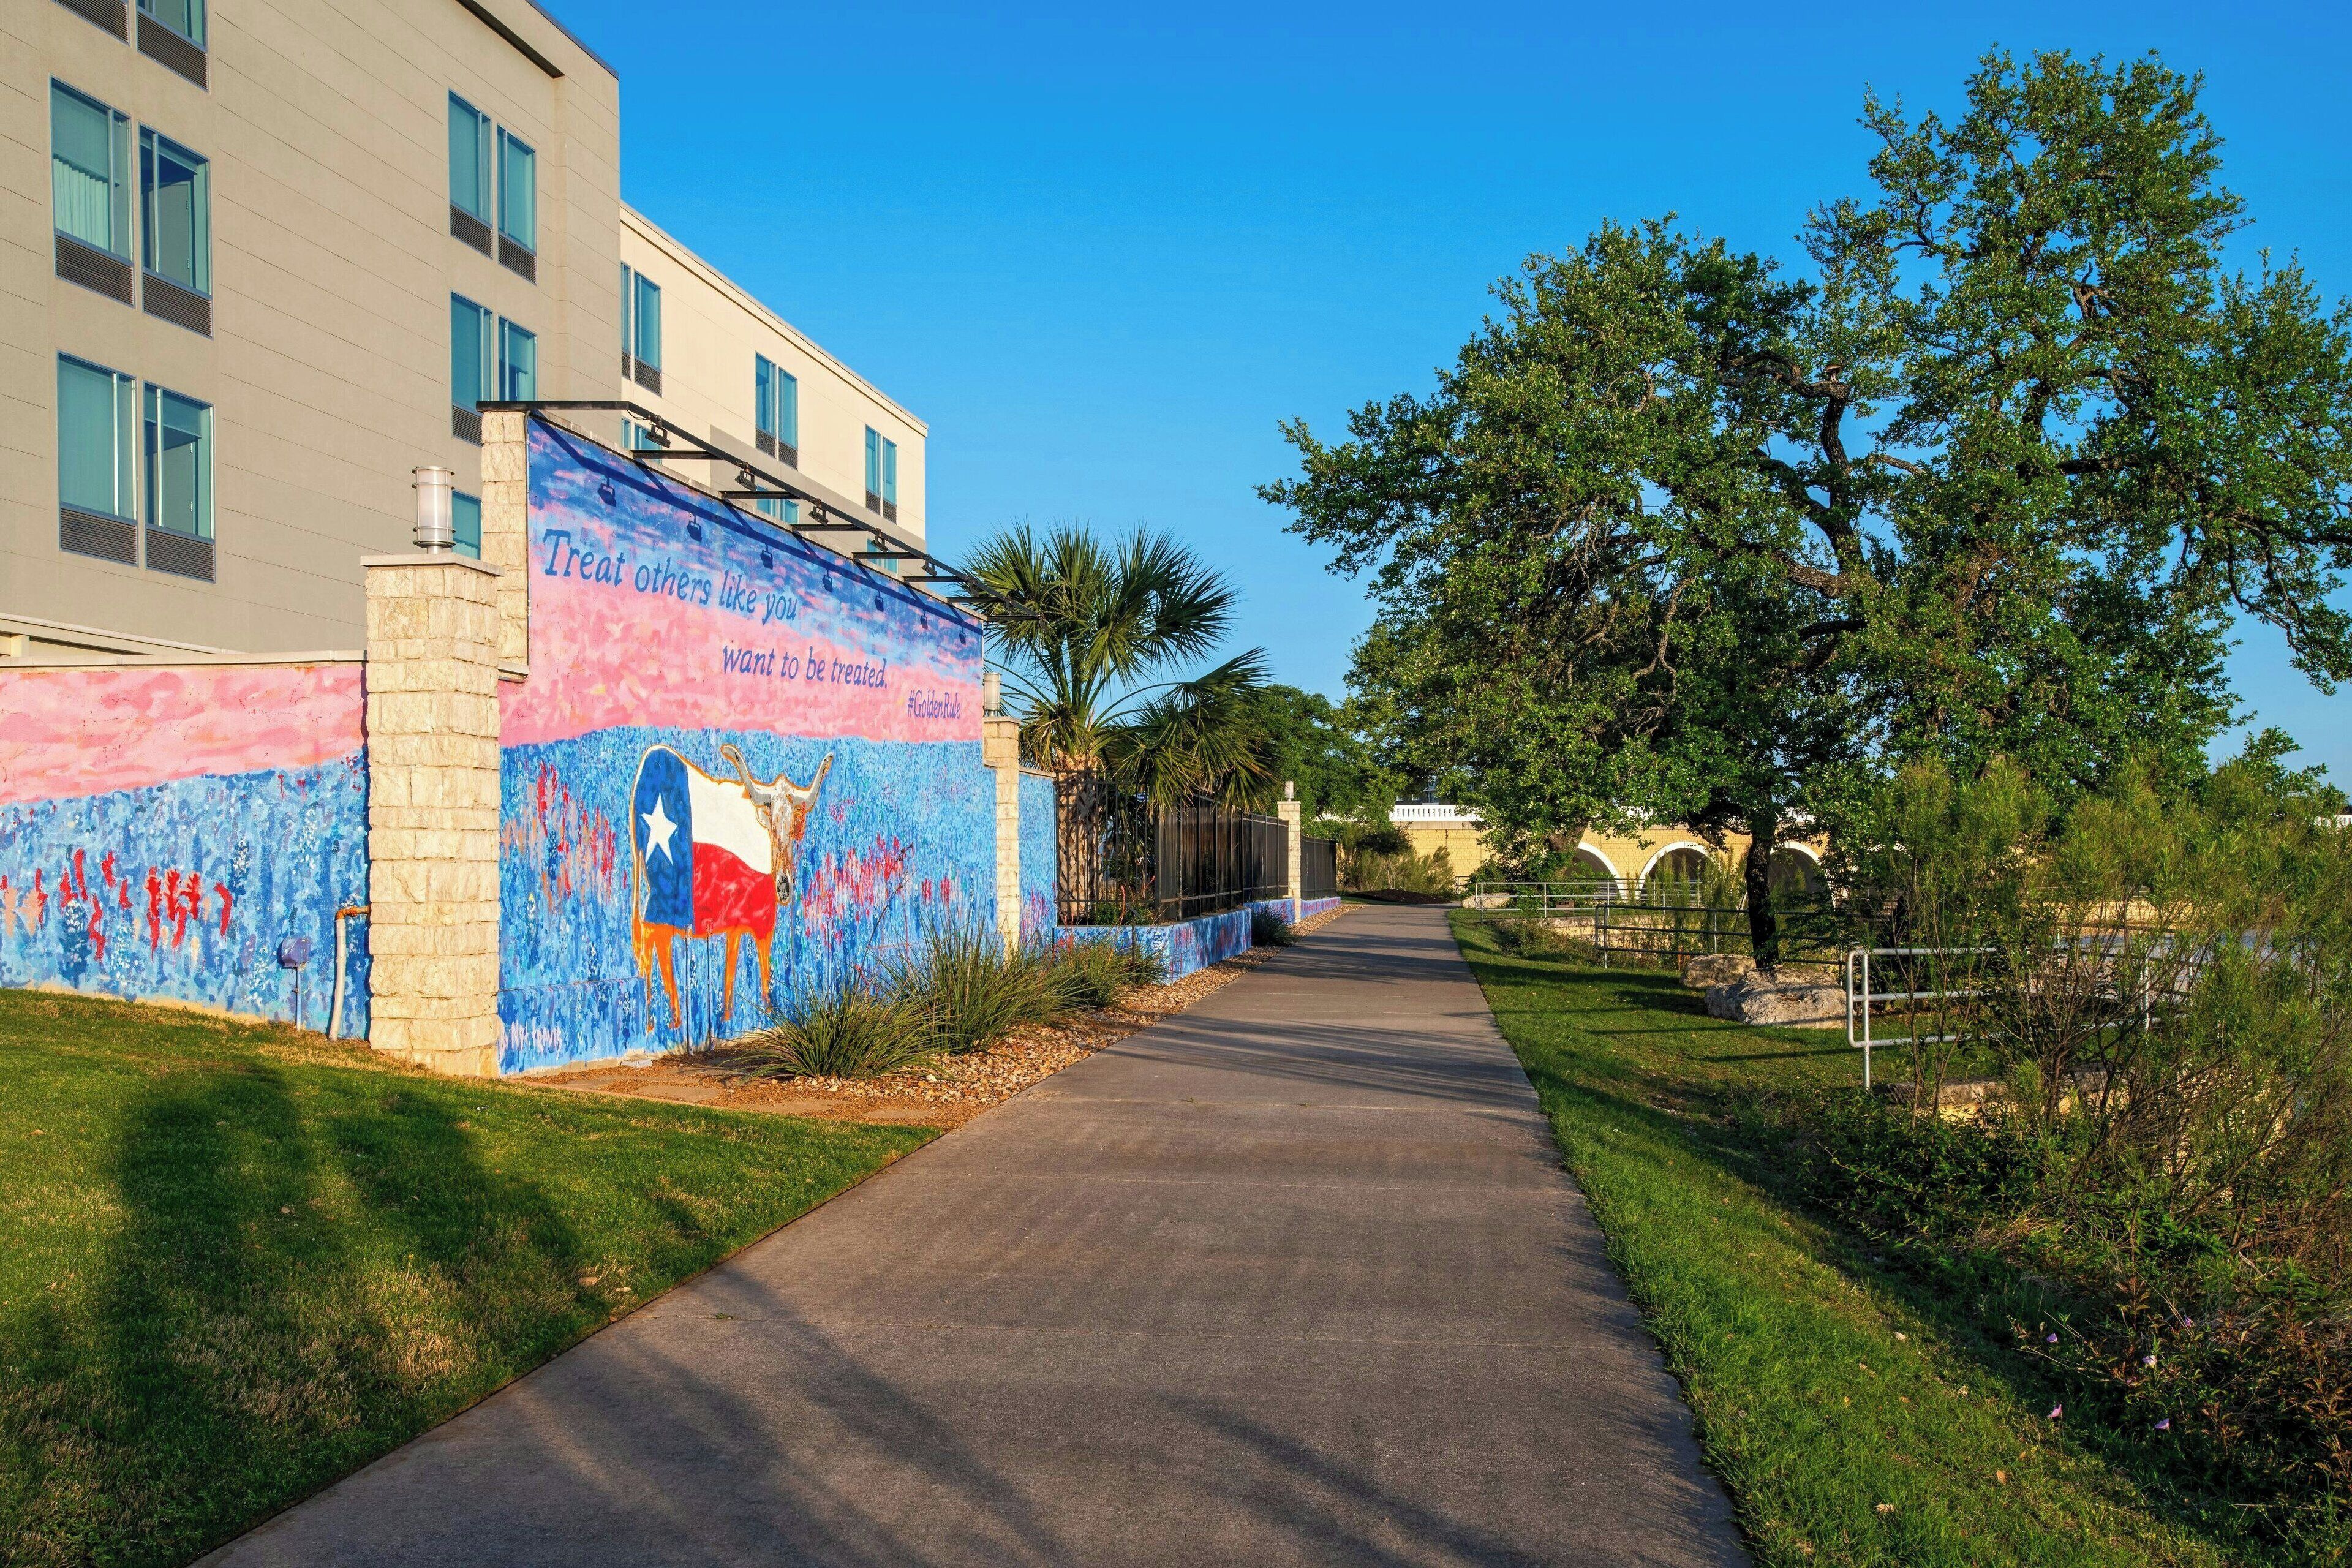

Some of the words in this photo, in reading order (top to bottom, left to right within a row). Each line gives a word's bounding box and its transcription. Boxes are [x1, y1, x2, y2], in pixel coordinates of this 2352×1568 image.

[543, 528, 625, 587] Treat
[635, 557, 712, 605] others
[718, 569, 757, 614] like
[761, 592, 797, 626] you
[722, 645, 775, 676] want
[780, 651, 799, 680] to
[805, 646, 826, 682] be
[831, 658, 888, 689] treated.
[907, 689, 962, 720] #GoldenRule
